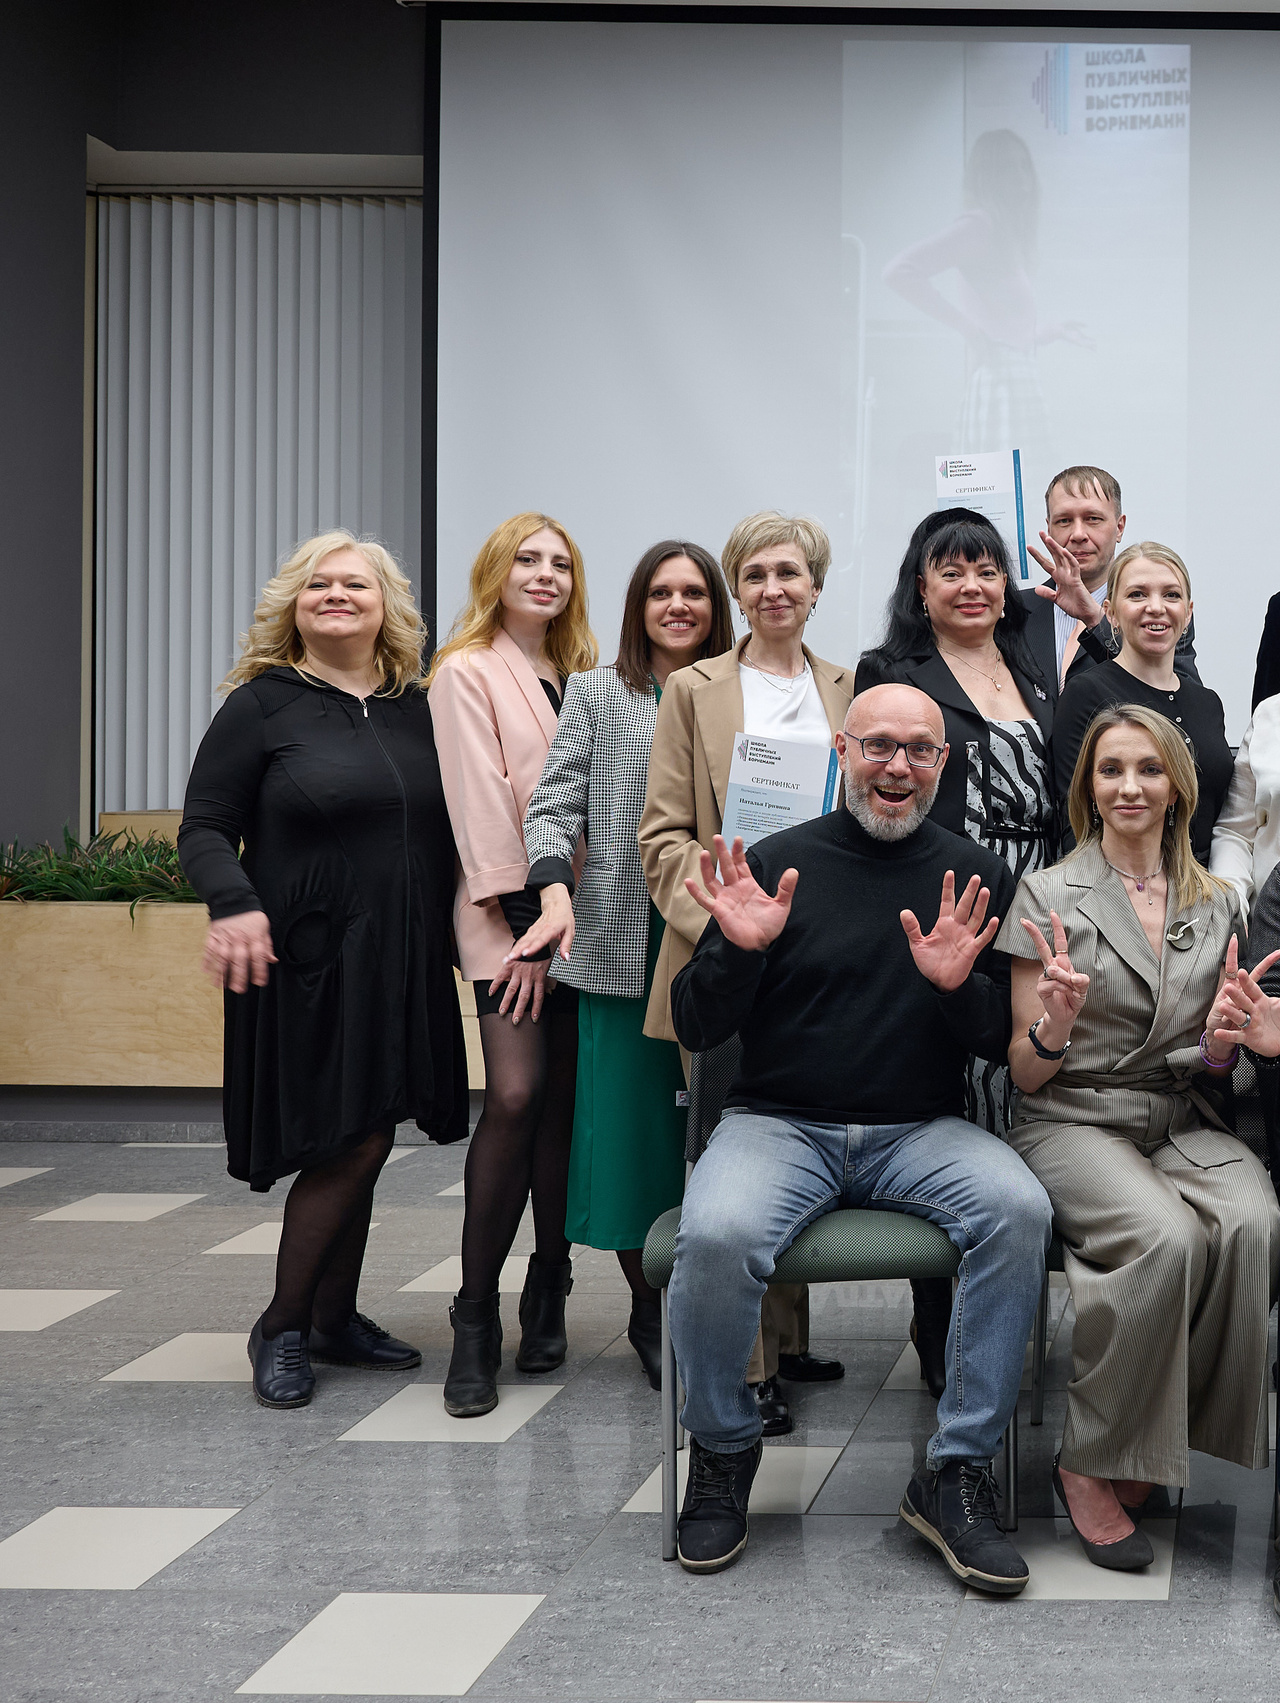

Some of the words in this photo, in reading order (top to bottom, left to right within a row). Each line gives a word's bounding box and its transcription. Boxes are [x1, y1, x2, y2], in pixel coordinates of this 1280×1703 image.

[1085, 48, 1146, 66] ШКОЛА
[1085, 67, 1188, 88] ПУБЛИЧНЫХ
[1085, 113, 1186, 132] БОРНЕМАНН
[955, 485, 996, 494] СЕРТИФИКАТ
[751, 776, 801, 790] СЕРТИФИКАТ
